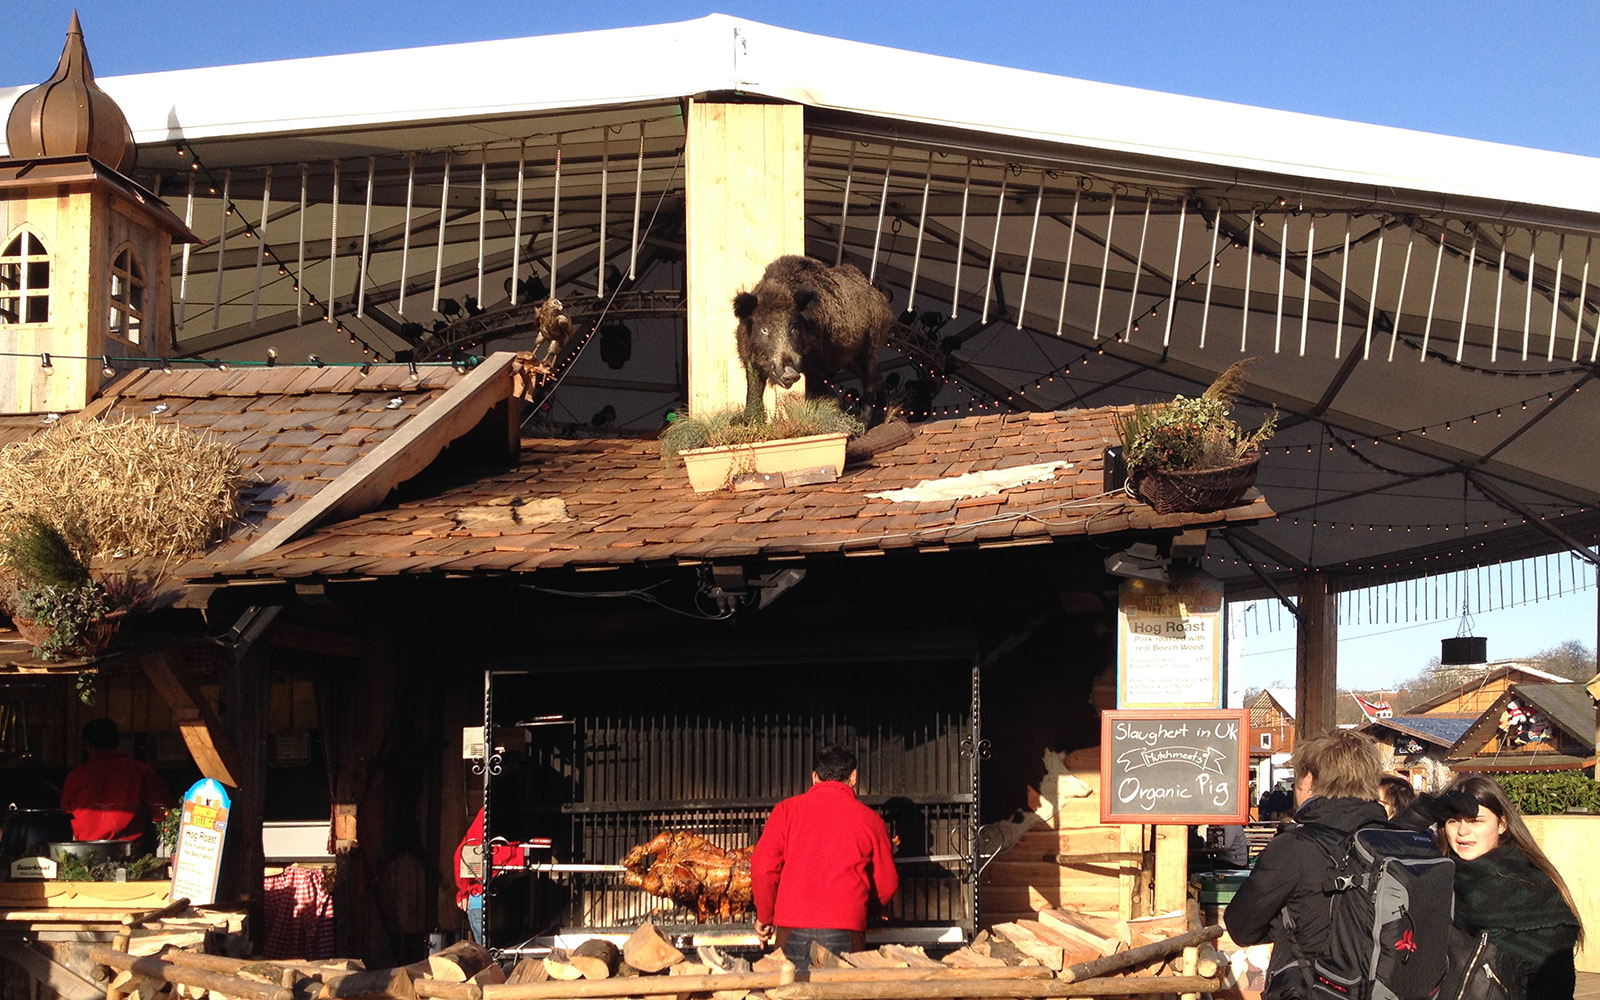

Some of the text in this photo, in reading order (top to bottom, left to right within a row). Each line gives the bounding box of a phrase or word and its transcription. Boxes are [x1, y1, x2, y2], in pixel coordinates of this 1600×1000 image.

[1134, 621, 1205, 634] Hog Roast
[1196, 727, 1211, 738] in
[1118, 773, 1229, 811] Organic Pig
[186, 828, 217, 844] Hog Roast
